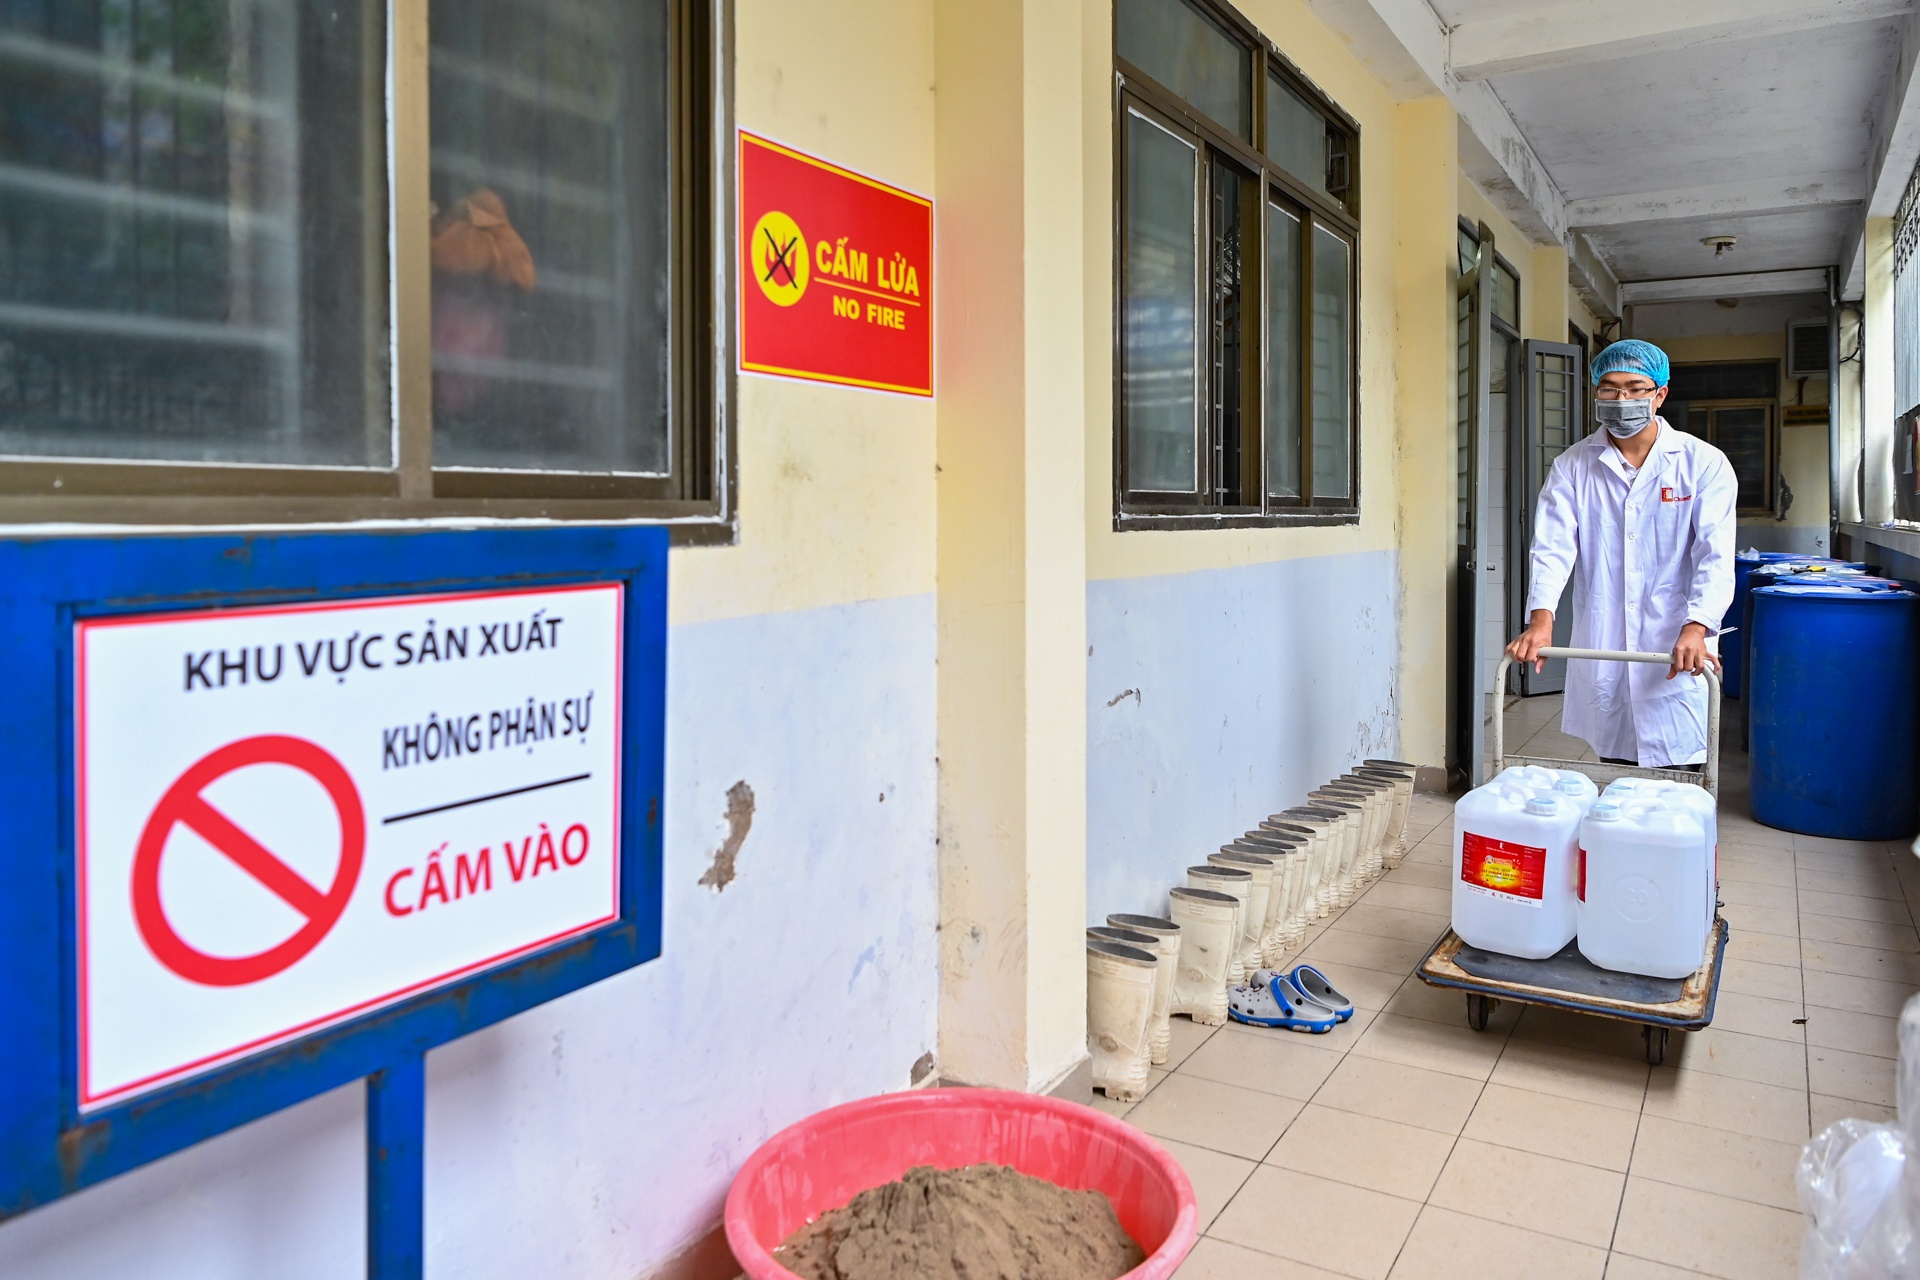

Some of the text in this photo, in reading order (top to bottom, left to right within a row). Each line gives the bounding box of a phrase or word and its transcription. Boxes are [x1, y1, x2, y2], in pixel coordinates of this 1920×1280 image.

[815, 237, 920, 297] CẤM LỬA
[832, 295, 906, 330] NO FIRE
[184, 608, 563, 691] KHU VỰC SẢN XUẤT
[382, 689, 594, 770] KHÔNG PHẬN SỰ
[384, 822, 590, 918] CẤM VÀO
